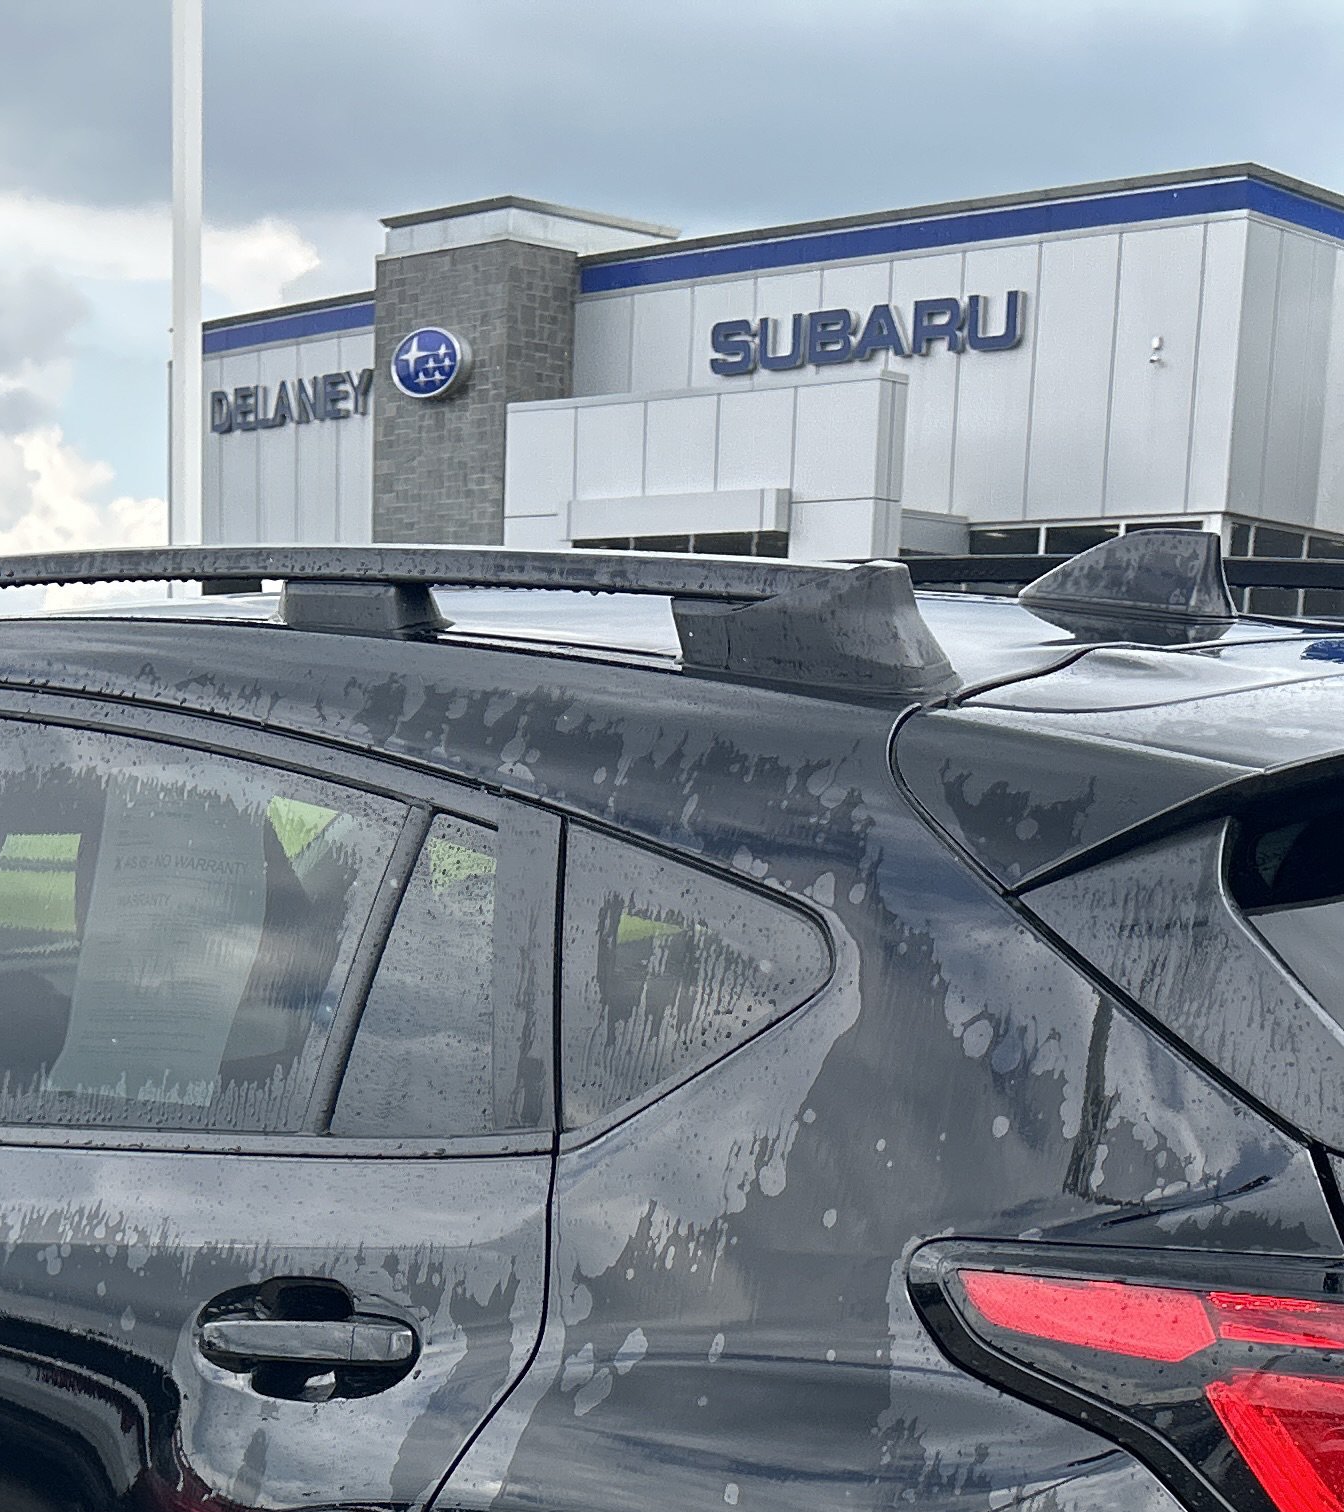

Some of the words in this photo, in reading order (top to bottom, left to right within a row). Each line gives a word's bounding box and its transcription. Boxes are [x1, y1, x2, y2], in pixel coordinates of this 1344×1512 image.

[710, 289, 1025, 377] SUBARU
[210, 368, 374, 434] DELANEY
[155, 854, 172, 869] NO
[174, 855, 248, 875] WARRANTY
